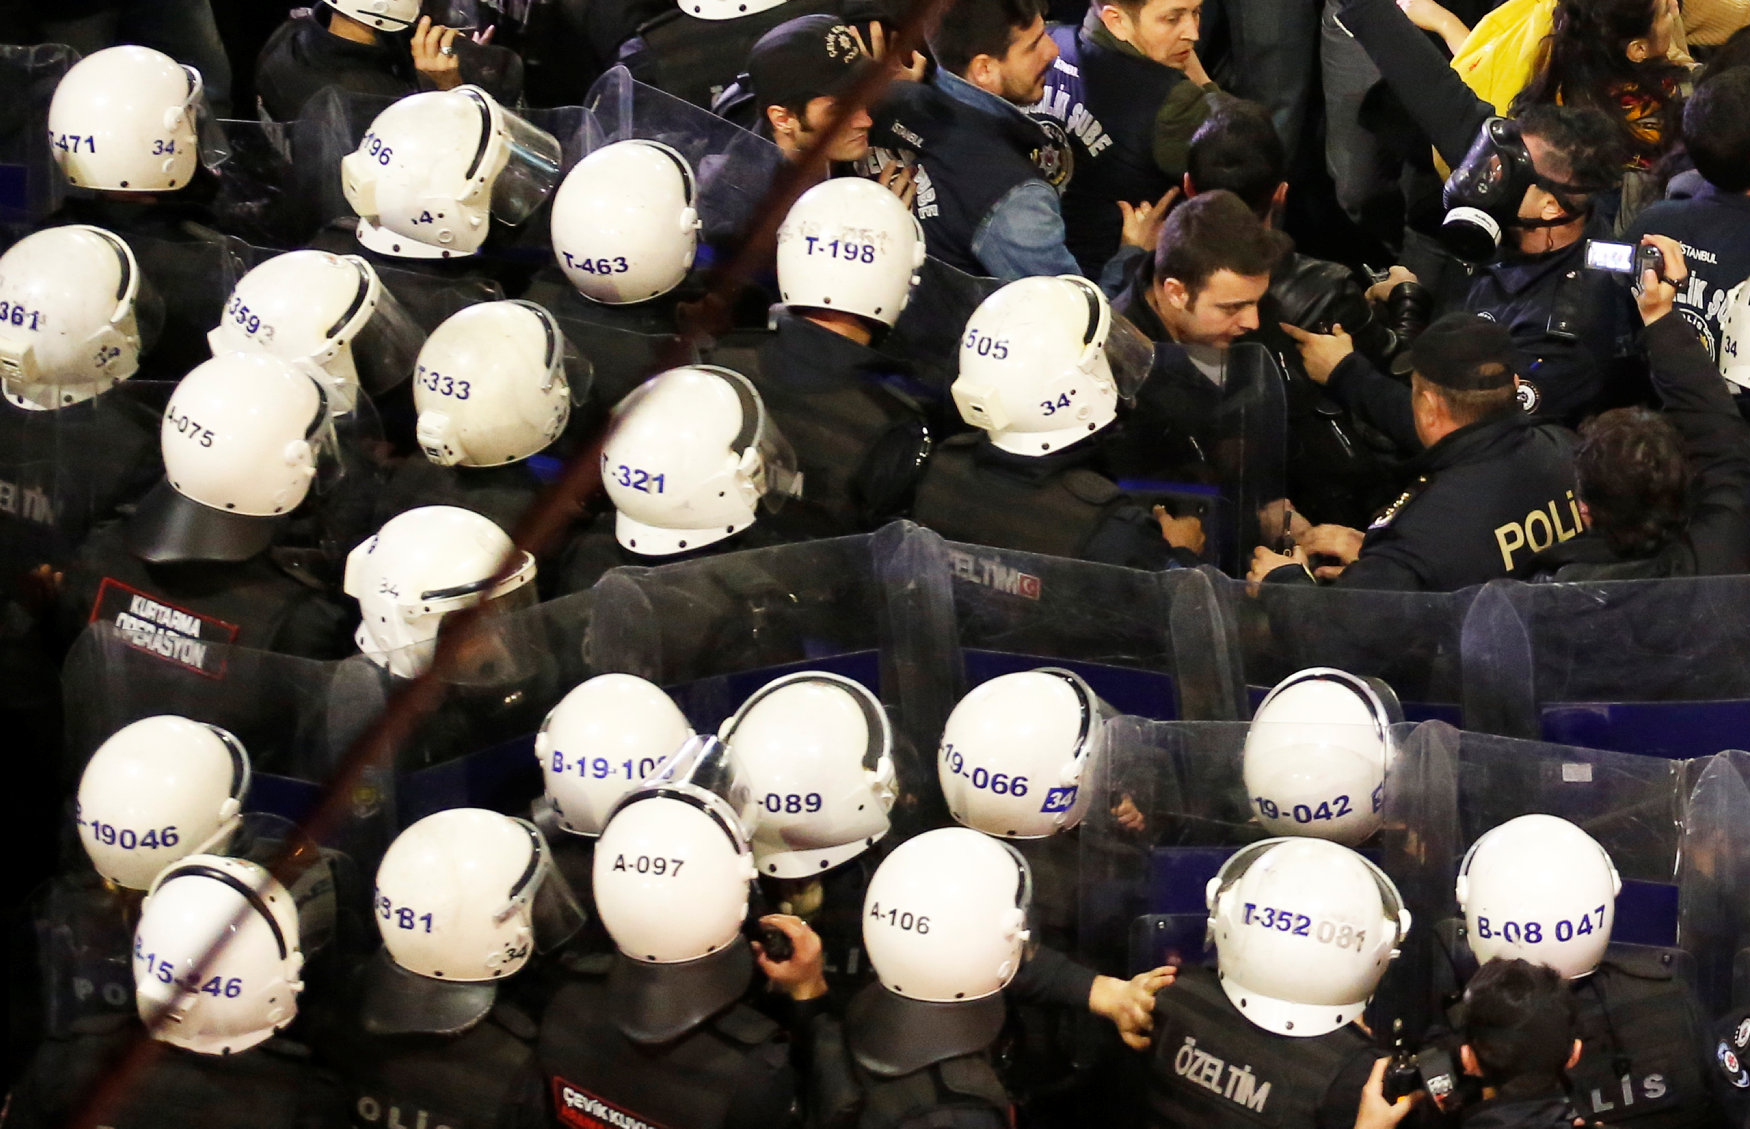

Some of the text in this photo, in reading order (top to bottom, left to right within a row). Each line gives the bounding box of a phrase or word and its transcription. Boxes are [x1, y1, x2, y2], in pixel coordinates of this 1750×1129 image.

[152, 140, 175, 155] 34
[562, 251, 629, 275] T-463
[805, 236, 875, 264] T-198
[1040, 393, 1071, 416] 34
[1494, 490, 1583, 572] POLİ
[130, 594, 201, 637] KURTARMA
[115, 613, 208, 669] OPERASYON
[1046, 787, 1076, 811] 34
[612, 854, 684, 878] A-097
[869, 901, 930, 935] A-106
[1243, 903, 1311, 936] T-352
[1477, 905, 1606, 944] B-08 047
